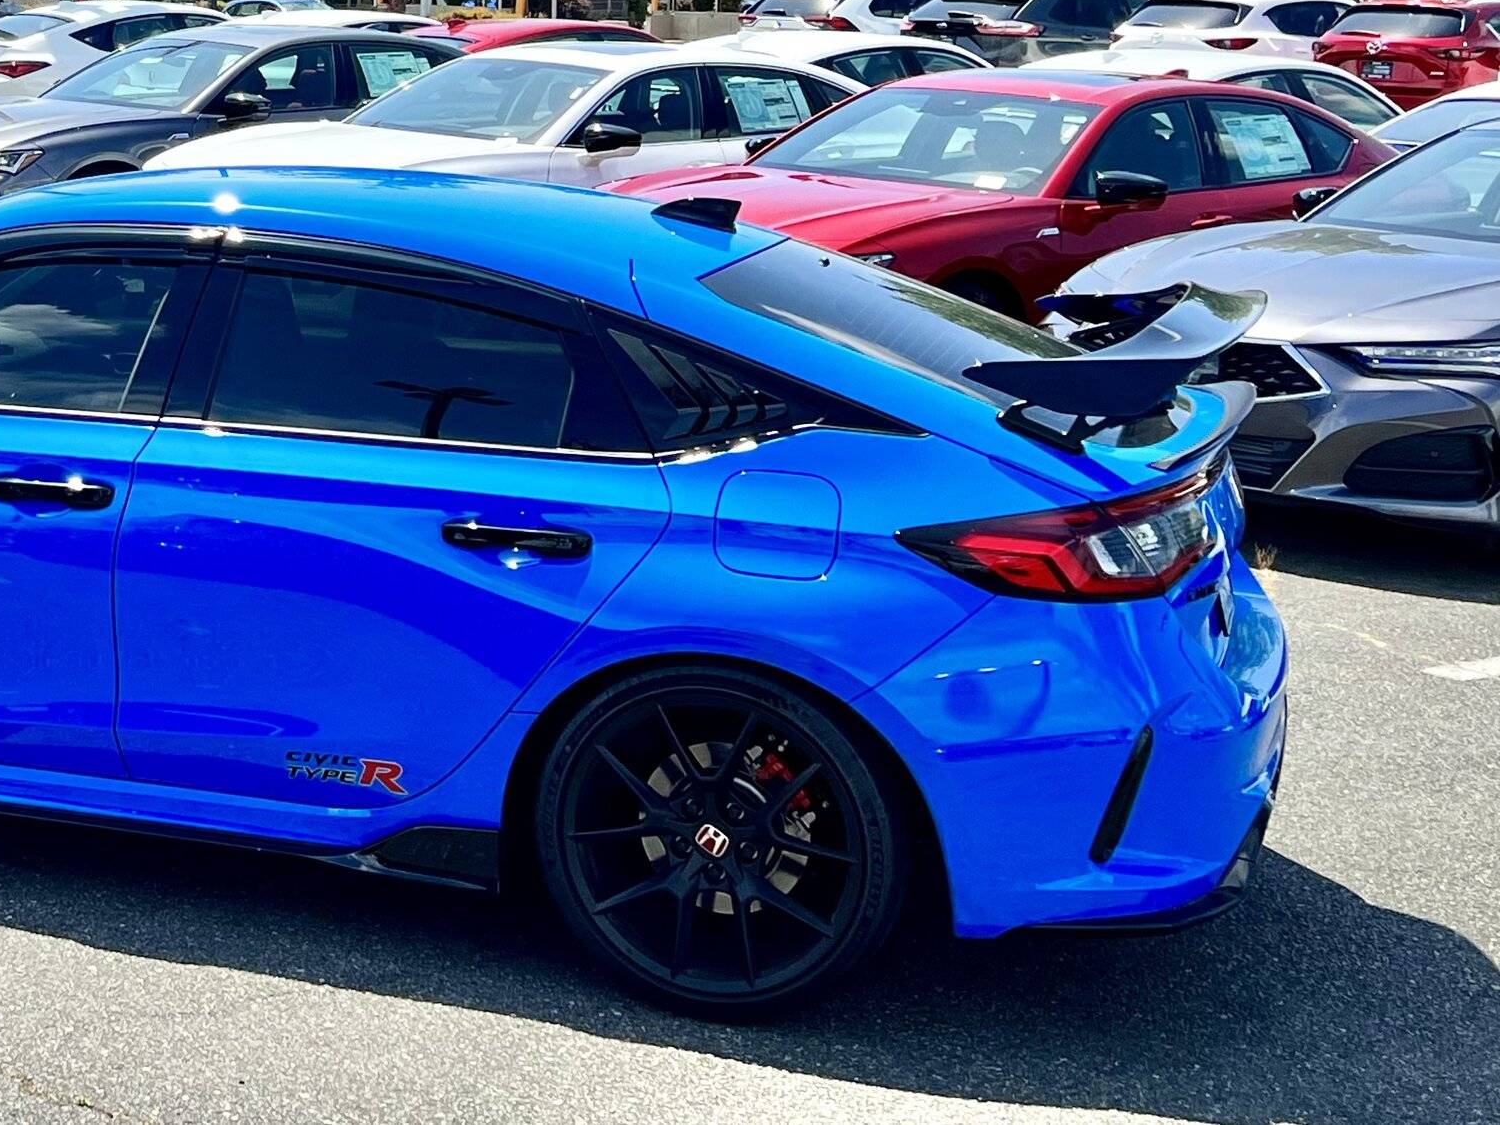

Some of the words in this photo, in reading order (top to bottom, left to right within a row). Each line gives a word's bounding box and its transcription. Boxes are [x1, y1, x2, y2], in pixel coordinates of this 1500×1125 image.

[286, 751, 358, 767] CIVIC
[286, 765, 357, 784] TYPE
[359, 758, 409, 795] R
